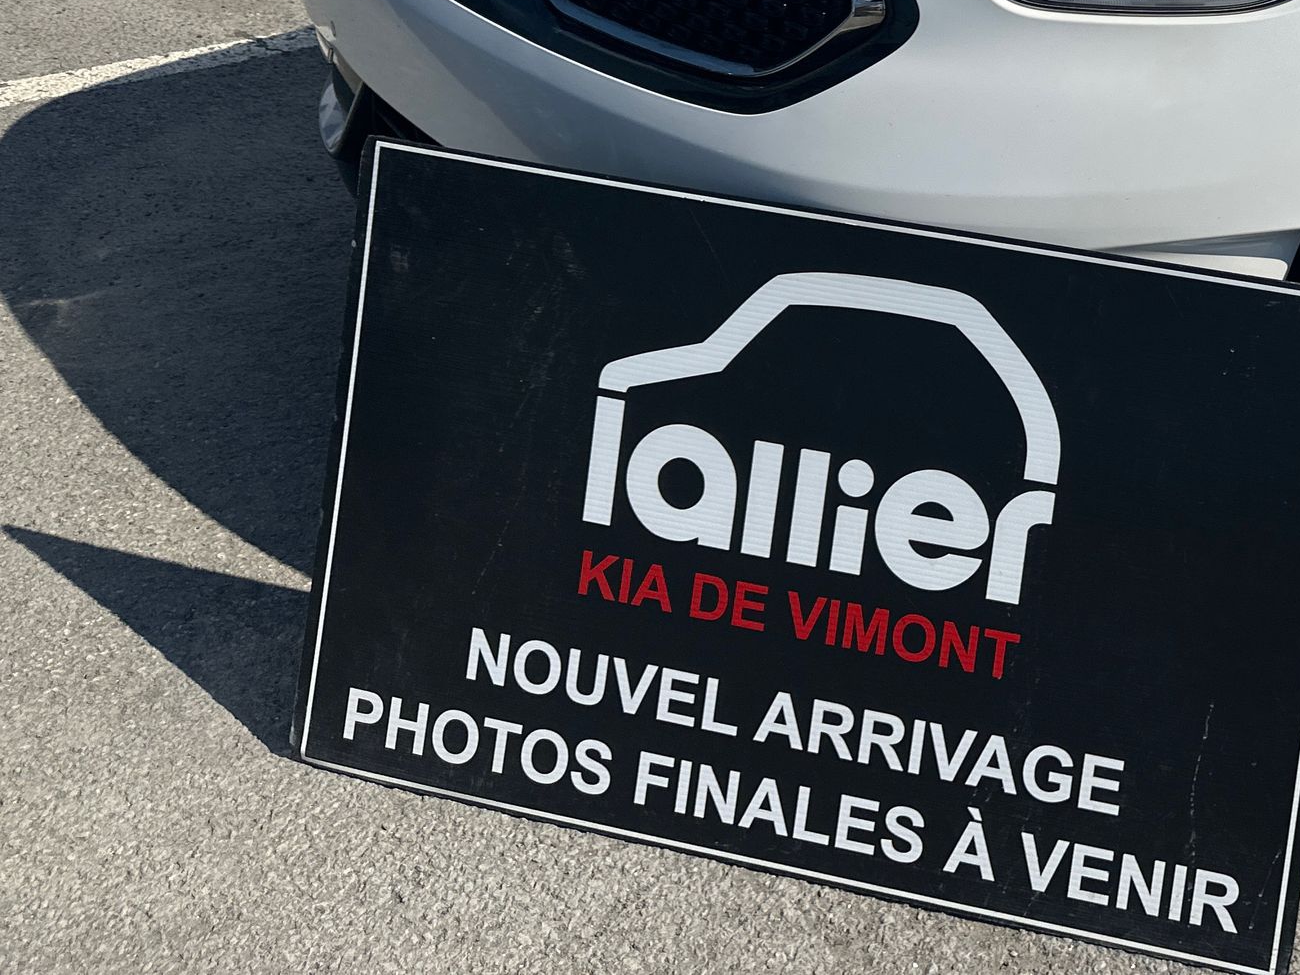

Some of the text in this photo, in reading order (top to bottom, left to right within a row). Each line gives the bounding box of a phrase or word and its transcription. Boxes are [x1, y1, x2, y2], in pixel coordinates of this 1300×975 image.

[578, 551, 1020, 678] KIA DE VIMONT
[343, 687, 1240, 934] PHOTOS FINALES À VENIR
[466, 628, 1125, 817] NOUVEL ARRIVAGE
